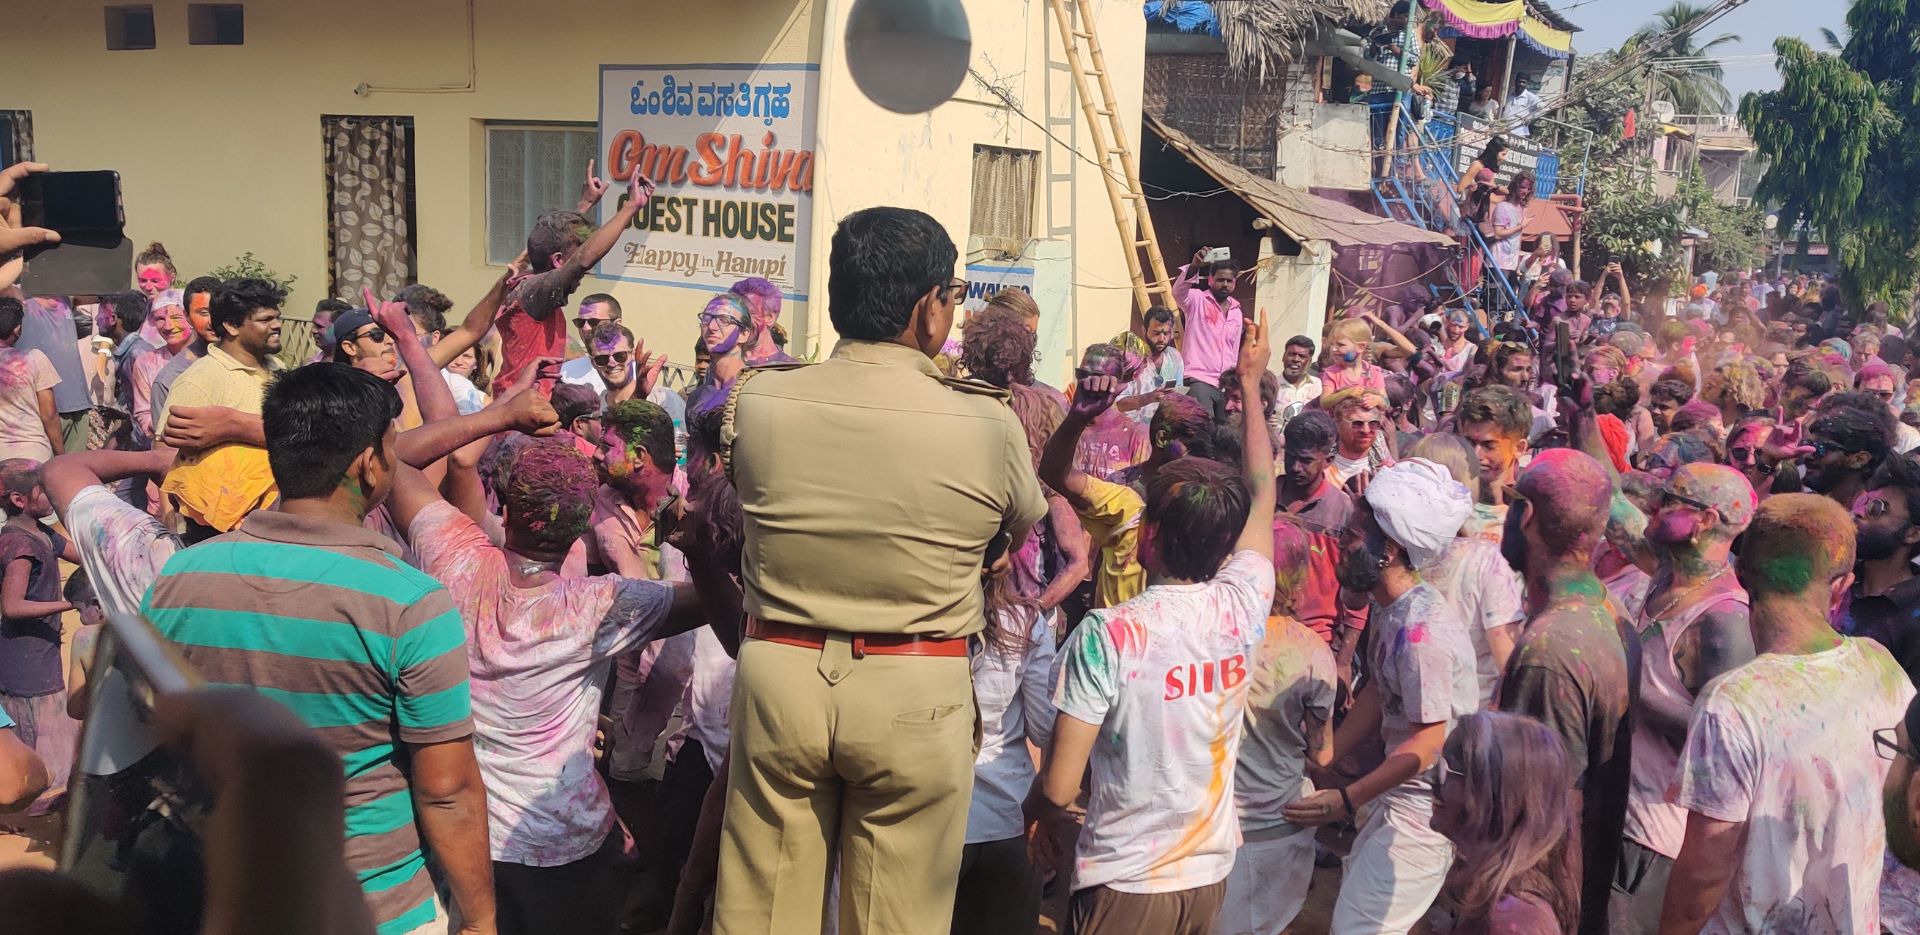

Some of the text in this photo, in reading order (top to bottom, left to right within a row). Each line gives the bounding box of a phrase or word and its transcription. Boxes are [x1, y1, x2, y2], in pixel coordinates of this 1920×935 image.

[608, 129, 814, 192] Om Shiva
[702, 199, 795, 243] HOUSE
[624, 241, 787, 278] Happy in Hampi
[1163, 654, 1247, 701] SIIB
